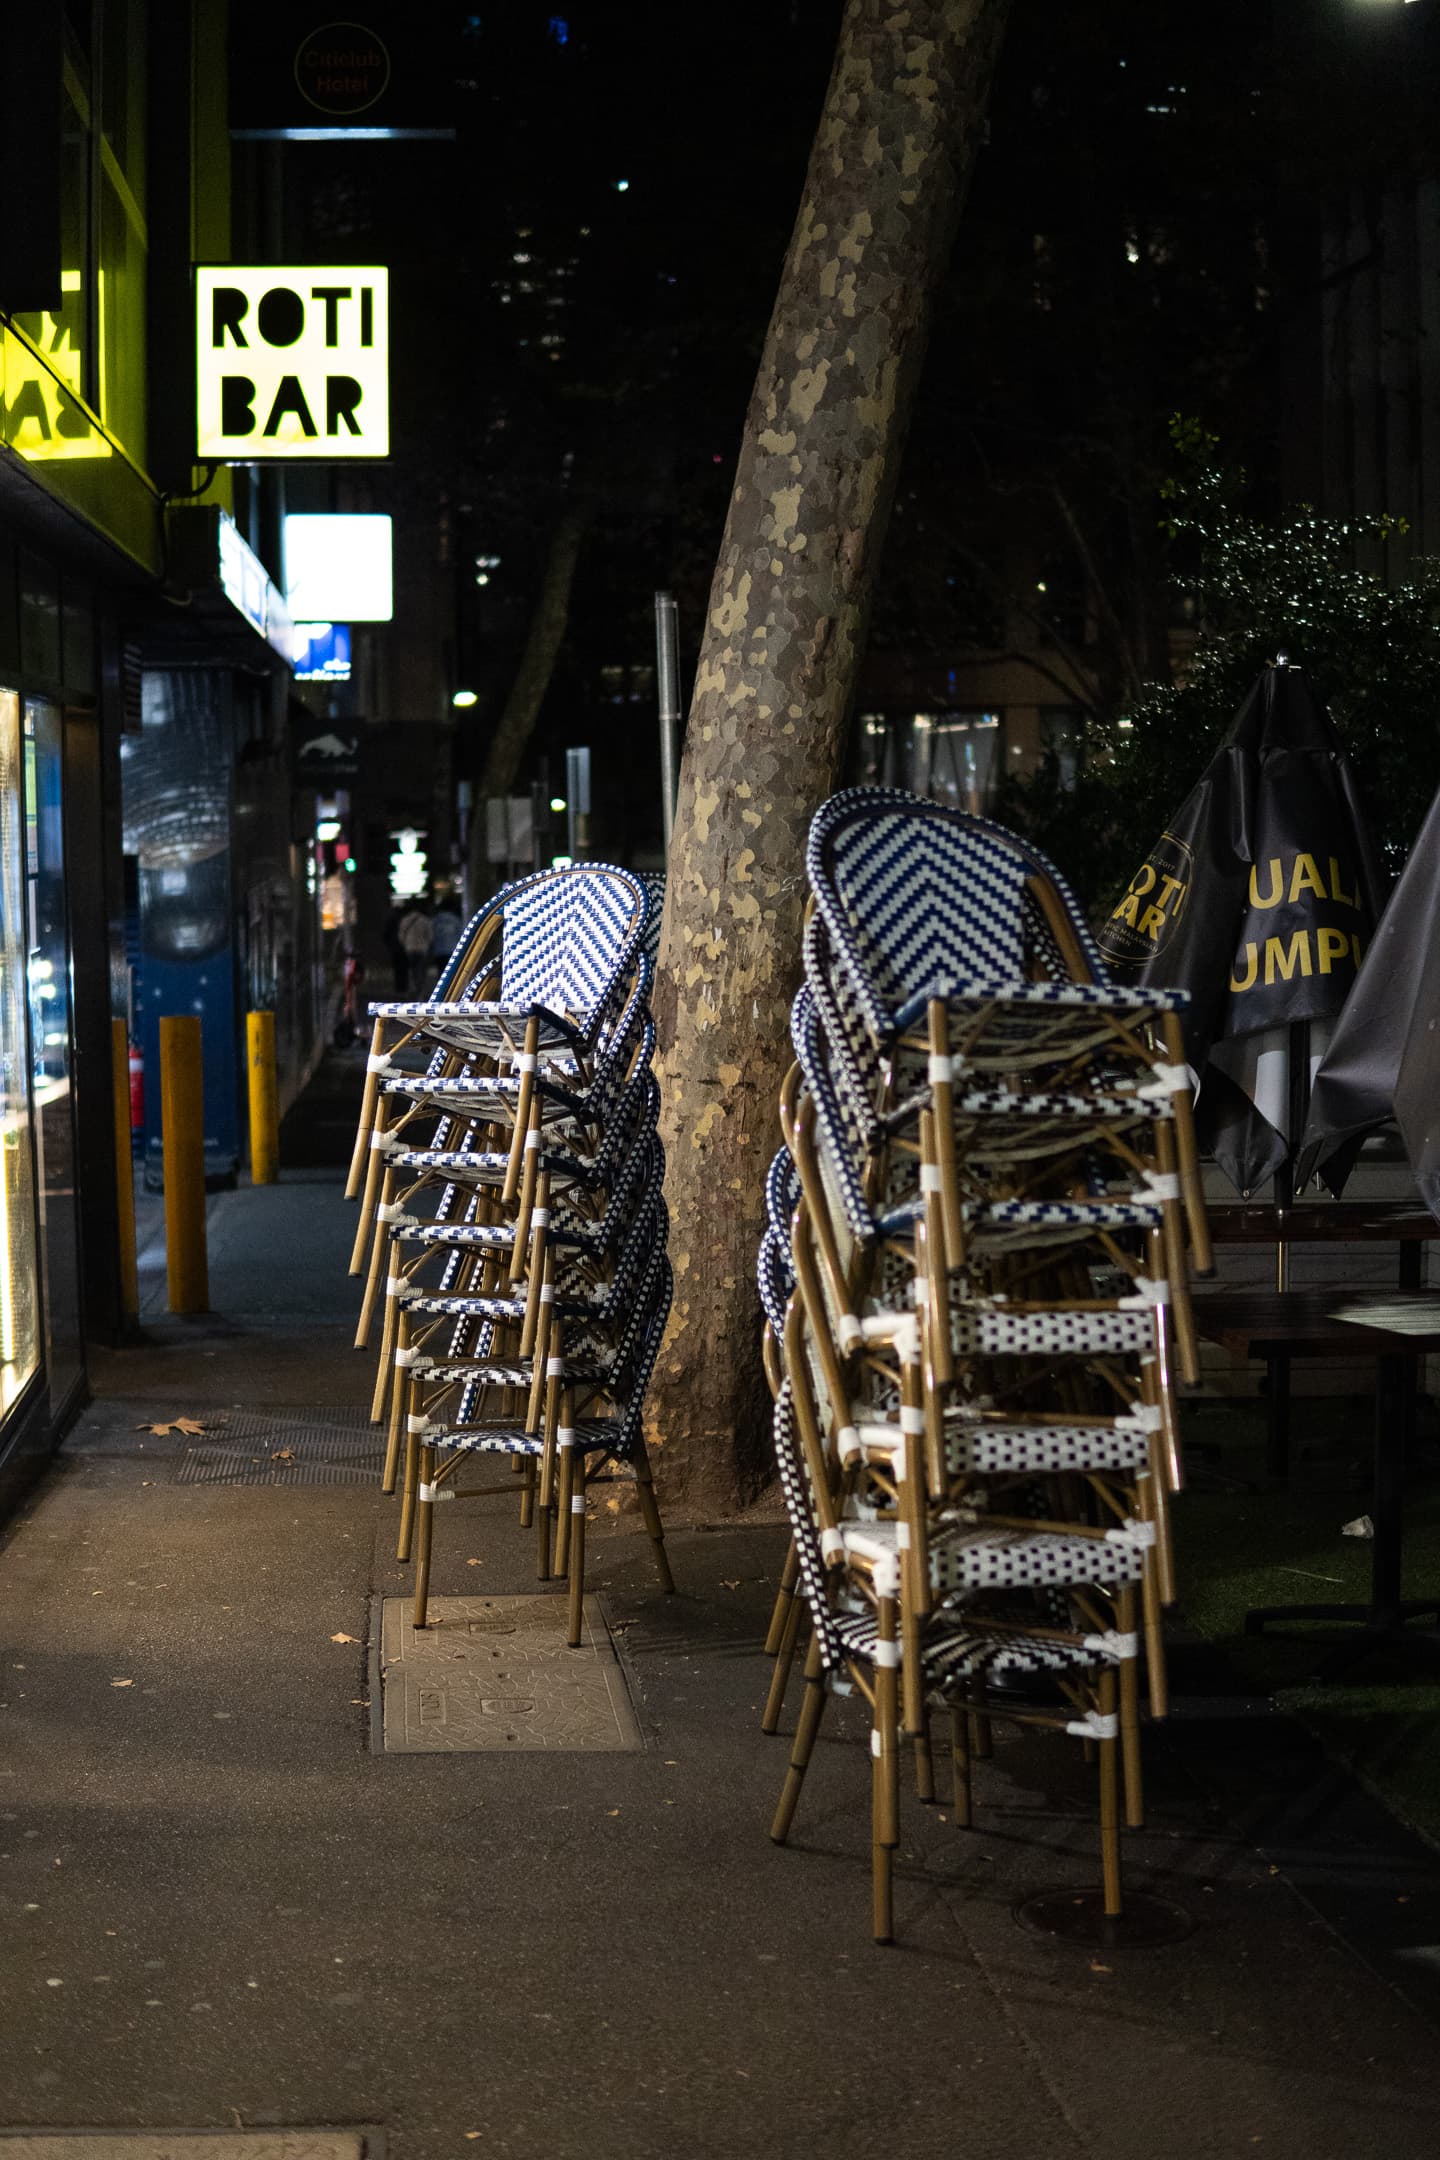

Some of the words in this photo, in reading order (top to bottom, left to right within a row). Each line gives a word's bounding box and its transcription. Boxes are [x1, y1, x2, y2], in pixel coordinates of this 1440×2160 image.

[212, 287, 373, 348] ROTI
[221, 375, 363, 437] BAR
[1111, 894, 1166, 941] AR
